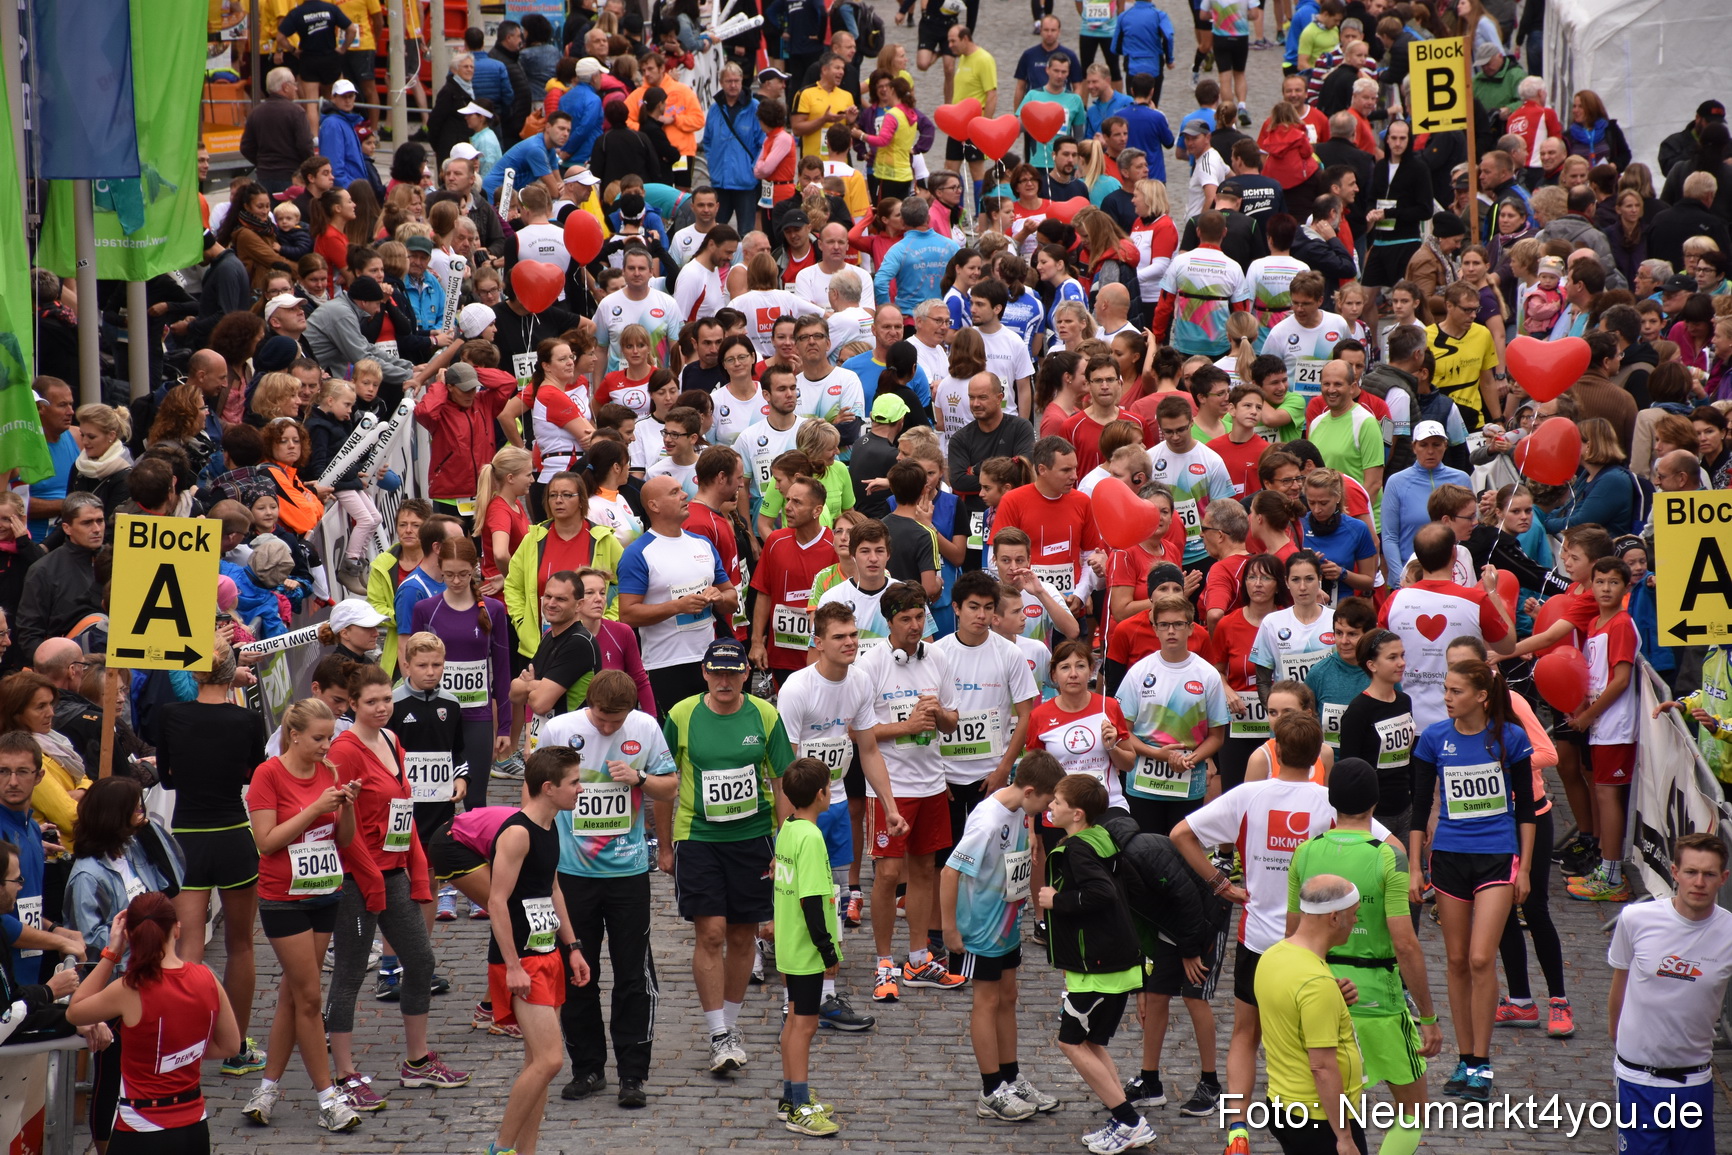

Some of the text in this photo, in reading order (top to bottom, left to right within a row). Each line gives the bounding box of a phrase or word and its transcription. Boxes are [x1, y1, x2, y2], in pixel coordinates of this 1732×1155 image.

[1089, 8, 1108, 17] 2758
[1416, 42, 1464, 61] Block
[1426, 67, 1457, 112] B
[1187, 266, 1227, 276] NeuerMarkt
[1299, 368, 1322, 382] 241
[381, 420, 398, 445] BMW
[340, 432, 362, 457] BMW
[1667, 498, 1732, 525] Bloc
[129, 521, 210, 553] Block
[1679, 537, 1732, 612] A
[131, 563, 192, 637] A
[289, 629, 318, 647] BMW
[787, 636, 806, 644] Daniel
[443, 673, 483, 691] 5068
[456, 696, 475, 704] atalie
[408, 764, 449, 783] 4100
[710, 779, 753, 802] 5023
[1149, 781, 1174, 790] Florian
[1451, 776, 1500, 798] 5000
[579, 795, 626, 815] 5070
[726, 805, 741, 814] Jörg
[1463, 801, 1491, 811] Samira
[584, 820, 621, 828] Alexander
[298, 853, 337, 876] 5040
[1011, 859, 1031, 883] 402
[303, 879, 333, 888] Elisabeth
[25, 911, 41, 930] 25
[1659, 956, 1700, 975] SGT
[175, 1050, 194, 1065] DEHN
